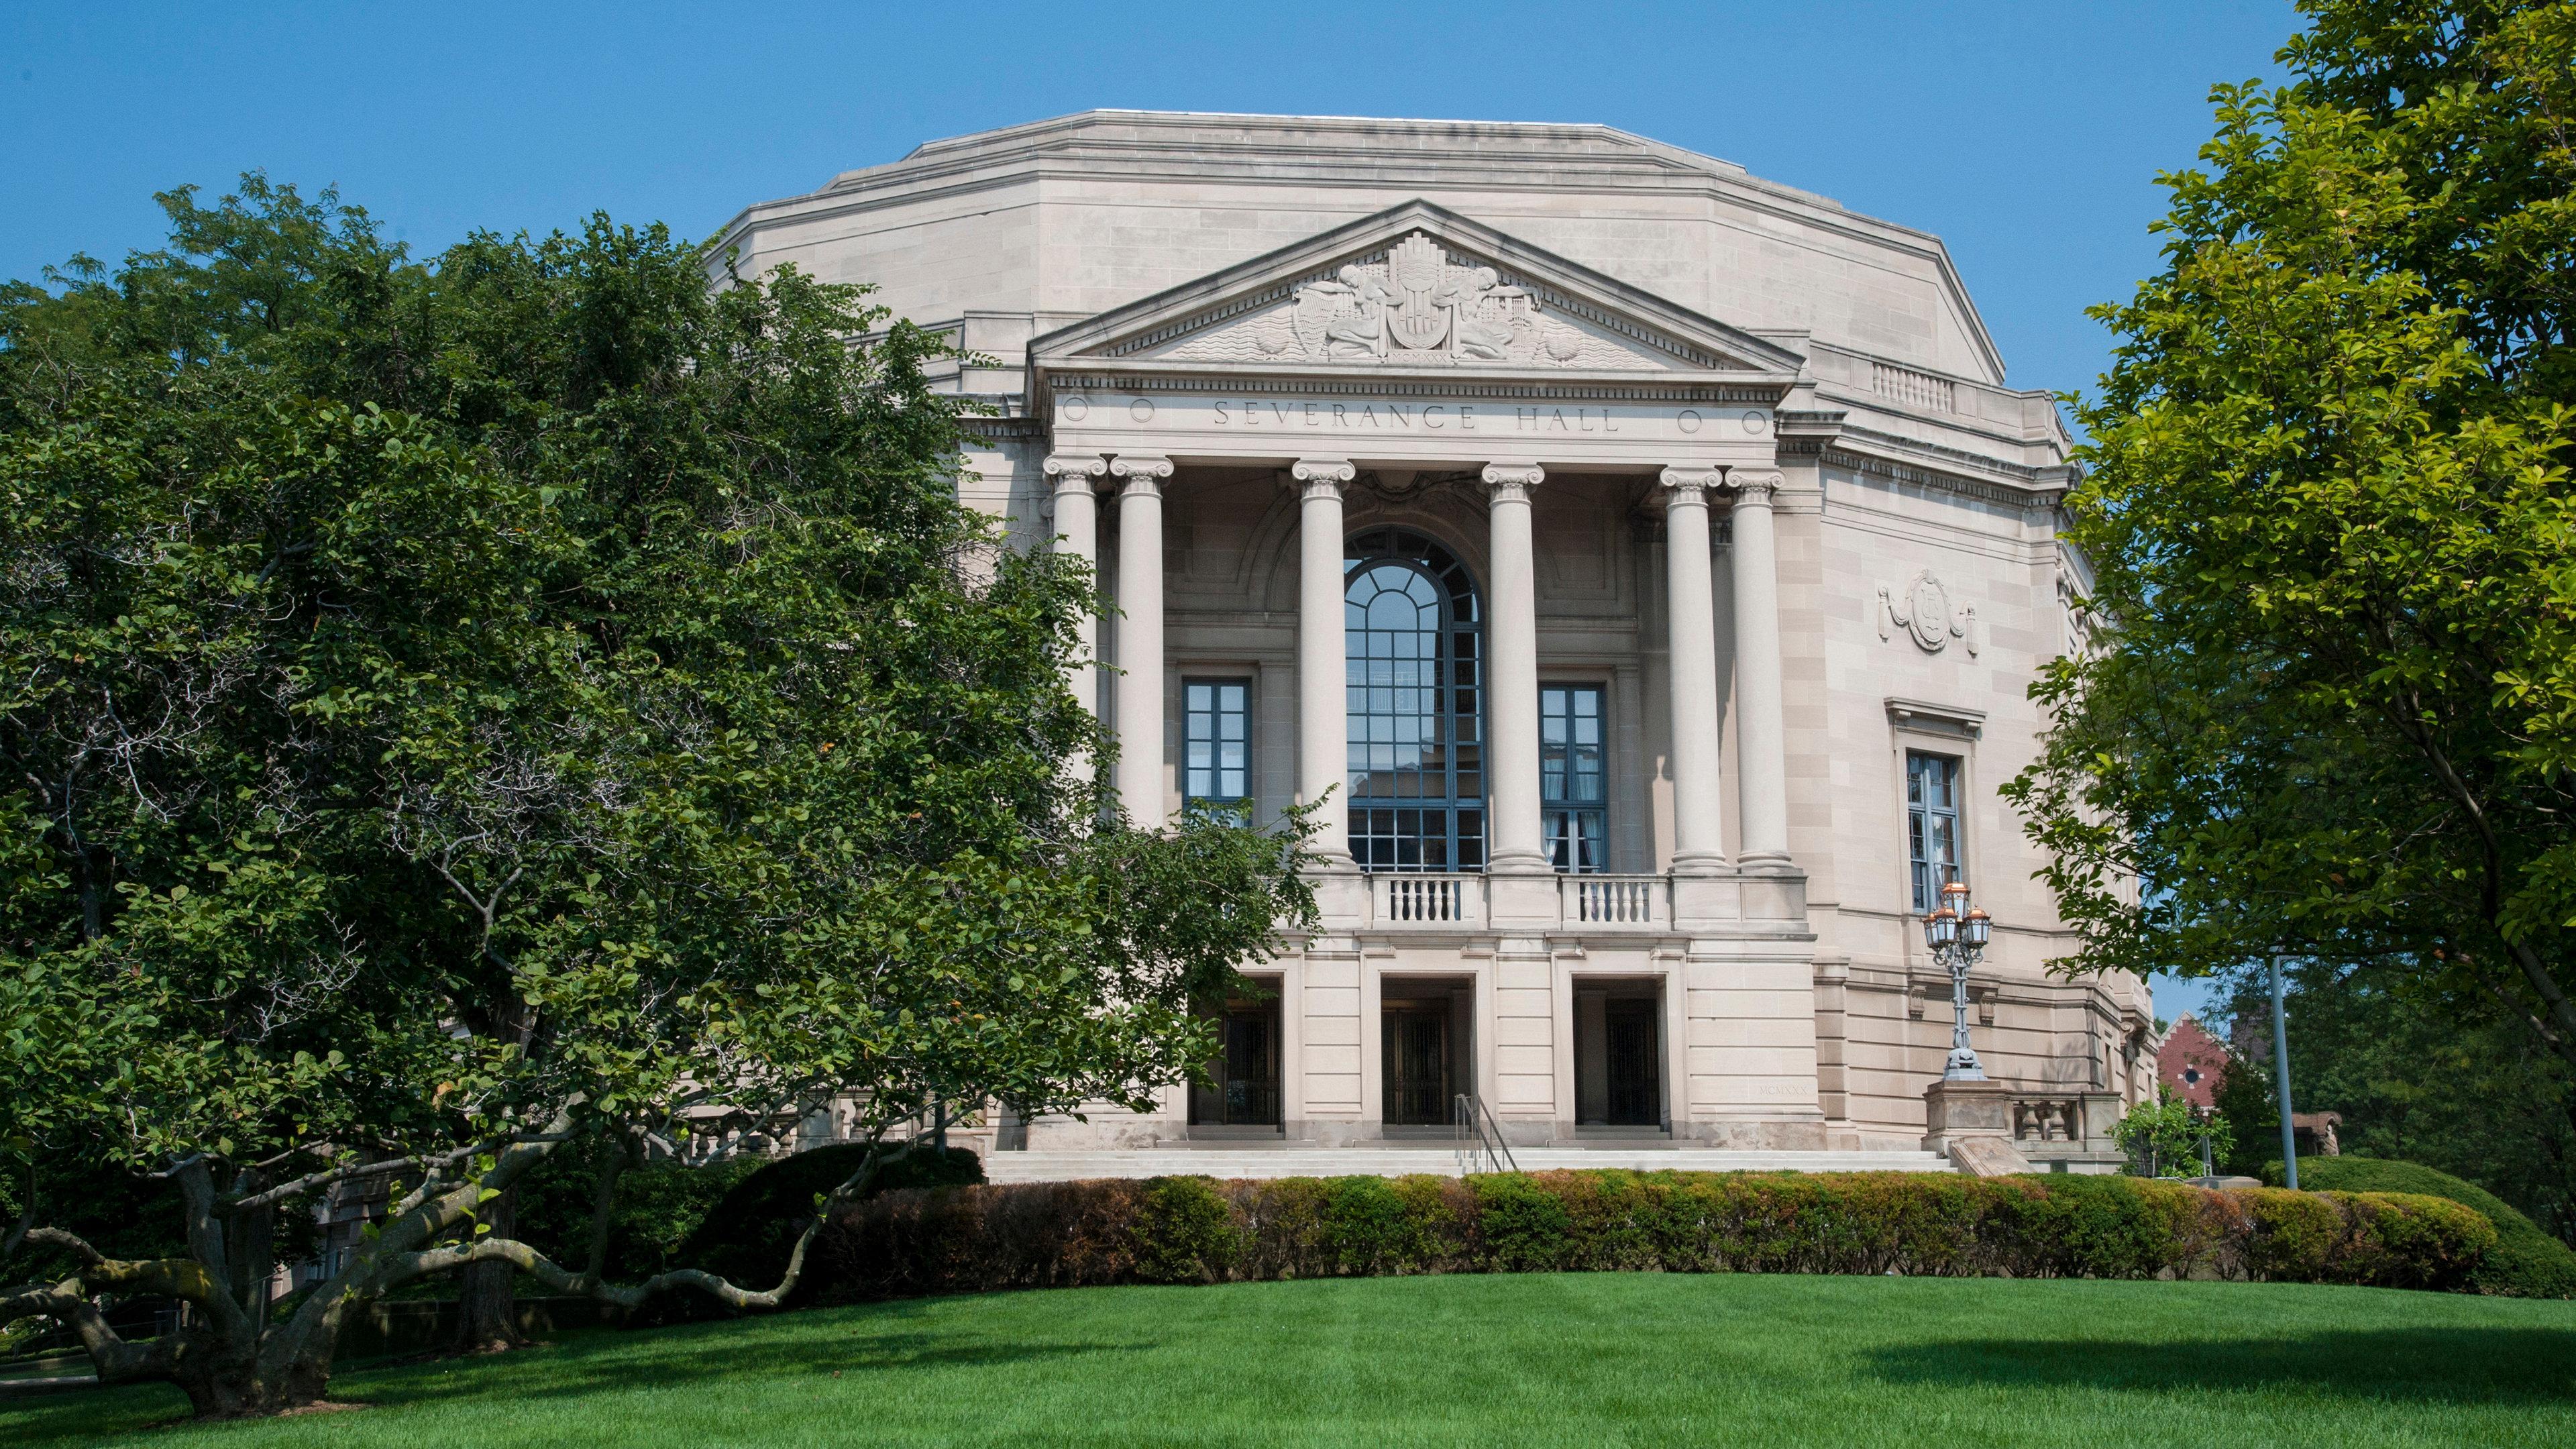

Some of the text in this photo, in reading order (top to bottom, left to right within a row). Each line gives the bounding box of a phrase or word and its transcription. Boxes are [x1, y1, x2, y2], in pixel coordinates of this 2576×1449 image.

[1214, 400, 1619, 431] SEVERANCE HALL
[1760, 1085, 1809, 1095] MCMXXX
